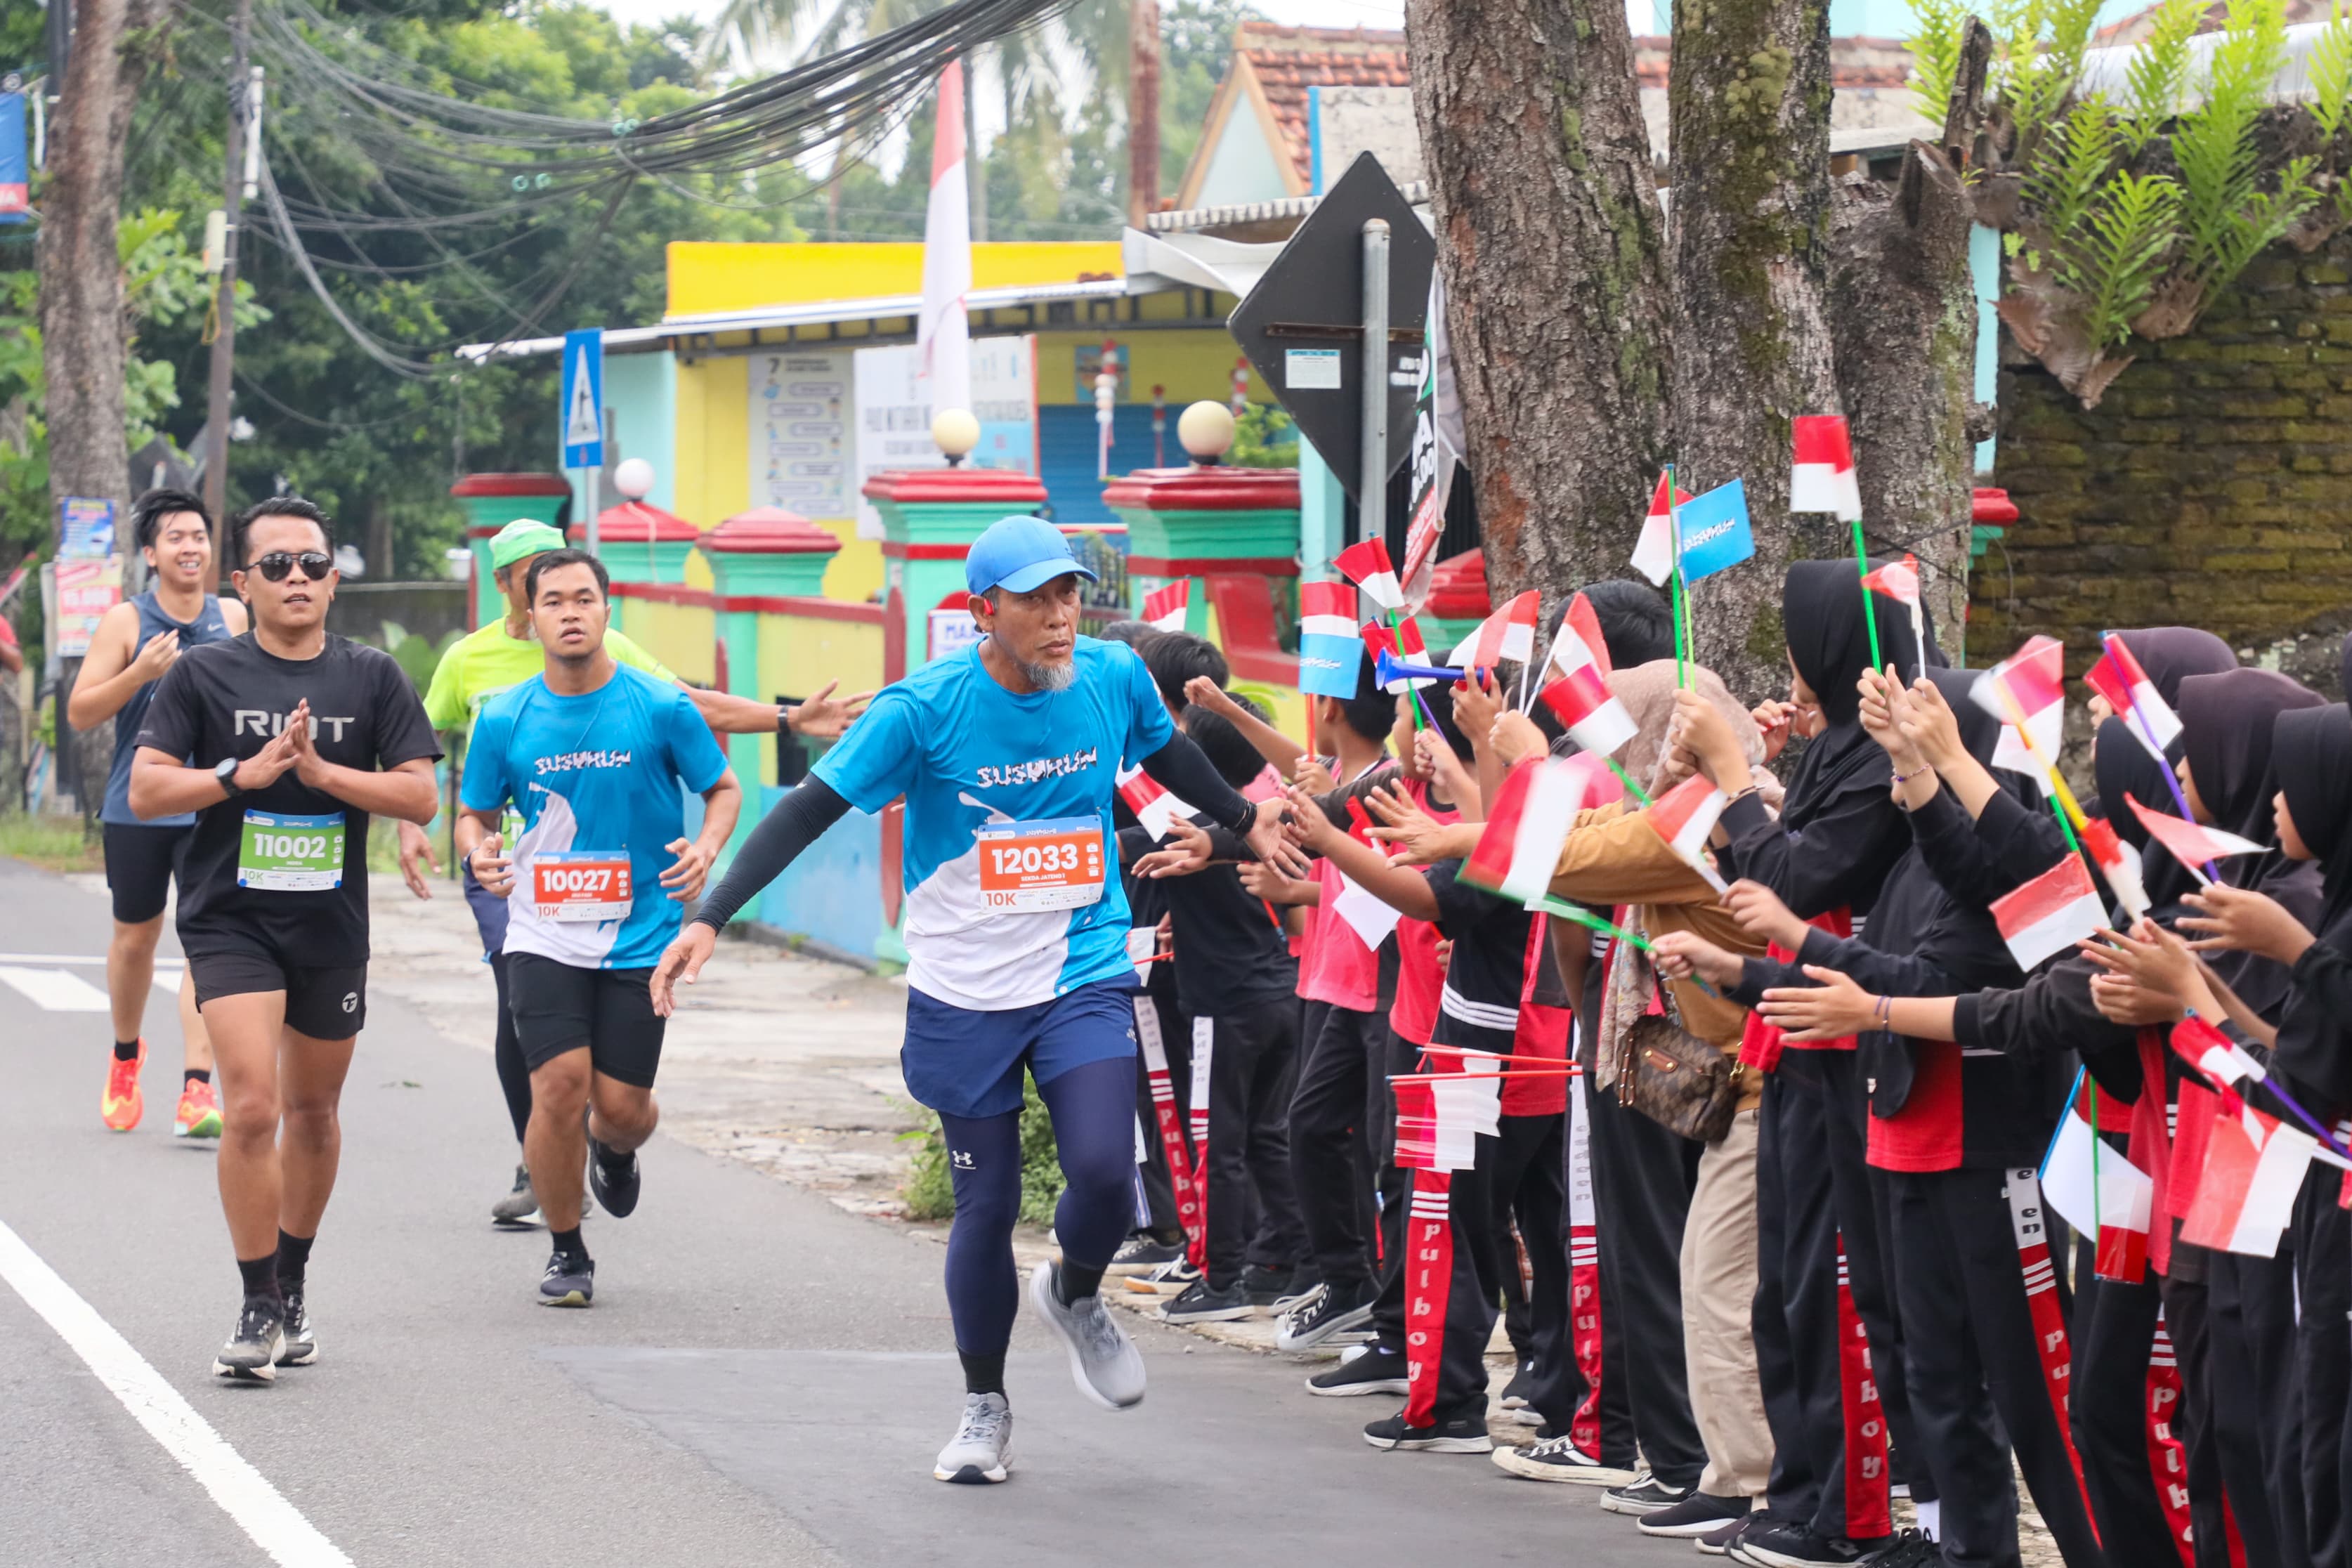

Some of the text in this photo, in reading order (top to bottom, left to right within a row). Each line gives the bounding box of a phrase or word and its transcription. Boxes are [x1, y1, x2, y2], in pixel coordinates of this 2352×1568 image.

[254, 832, 327, 859] 11002
[991, 843, 1078, 875] 12033
[243, 870, 264, 880] 10K
[542, 869, 612, 892] 10027
[986, 892, 1017, 906] 10K
[537, 906, 560, 917] 10K
